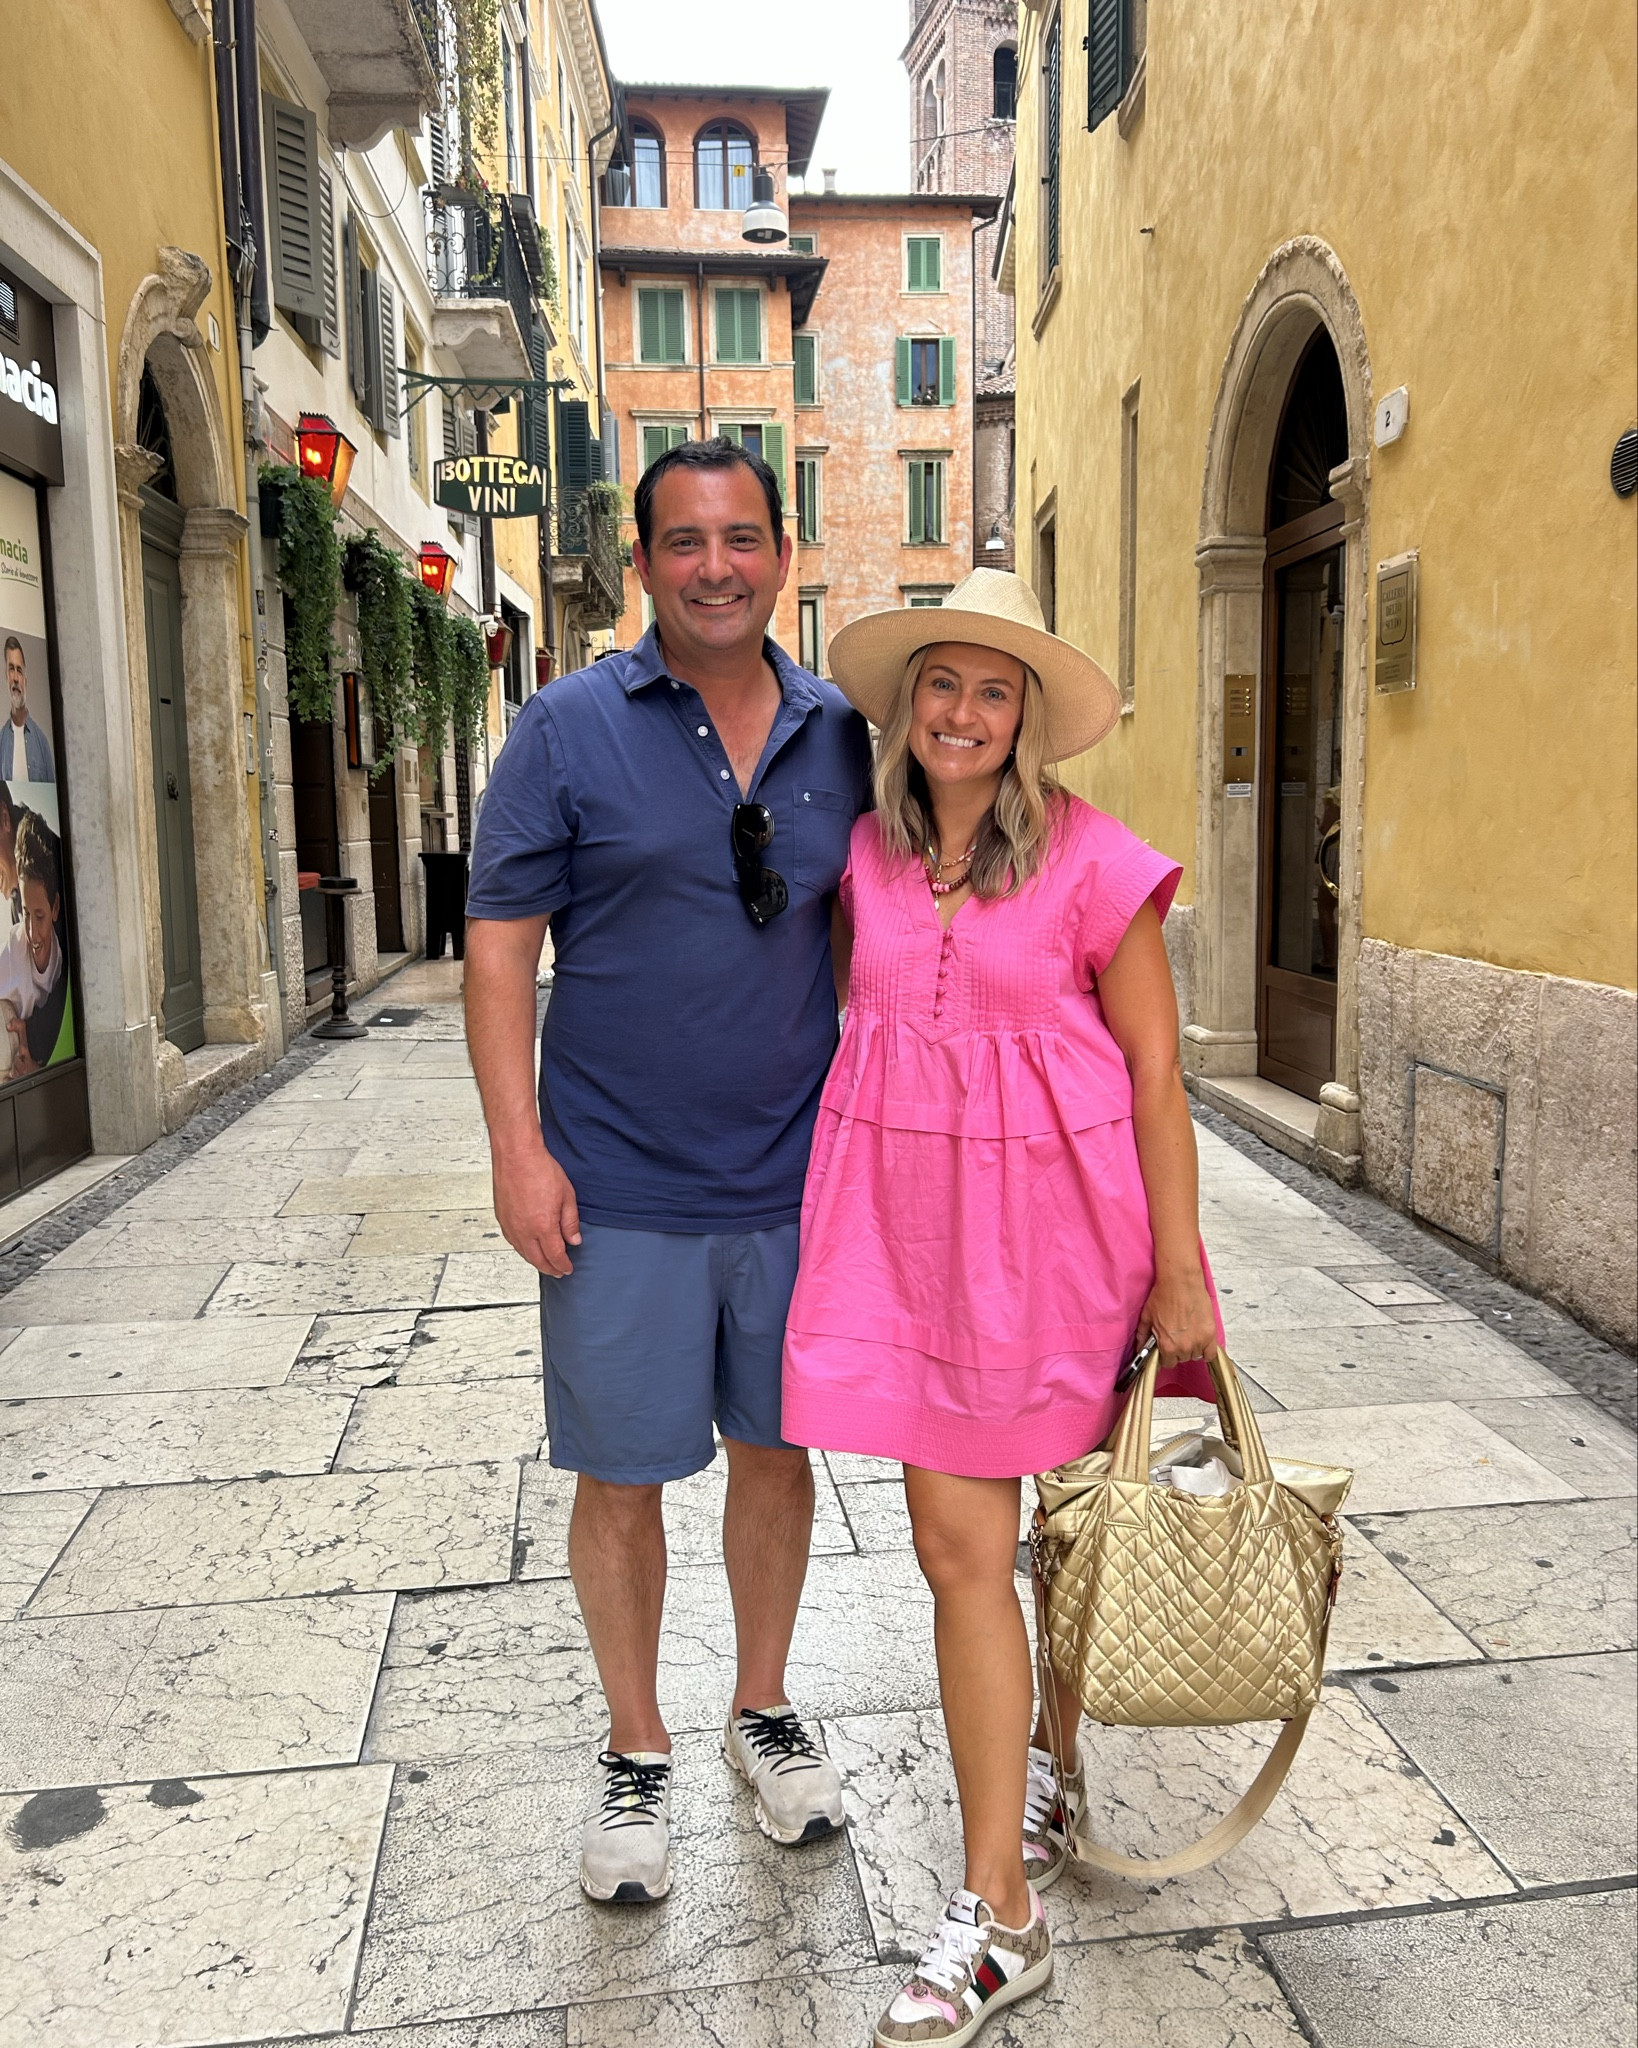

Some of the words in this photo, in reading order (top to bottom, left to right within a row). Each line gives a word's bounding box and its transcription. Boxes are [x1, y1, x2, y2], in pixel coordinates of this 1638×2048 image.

[1385, 410, 1391, 428] 2
[441, 456, 542, 485] BOTTEGA
[468, 485, 516, 513] VINI
